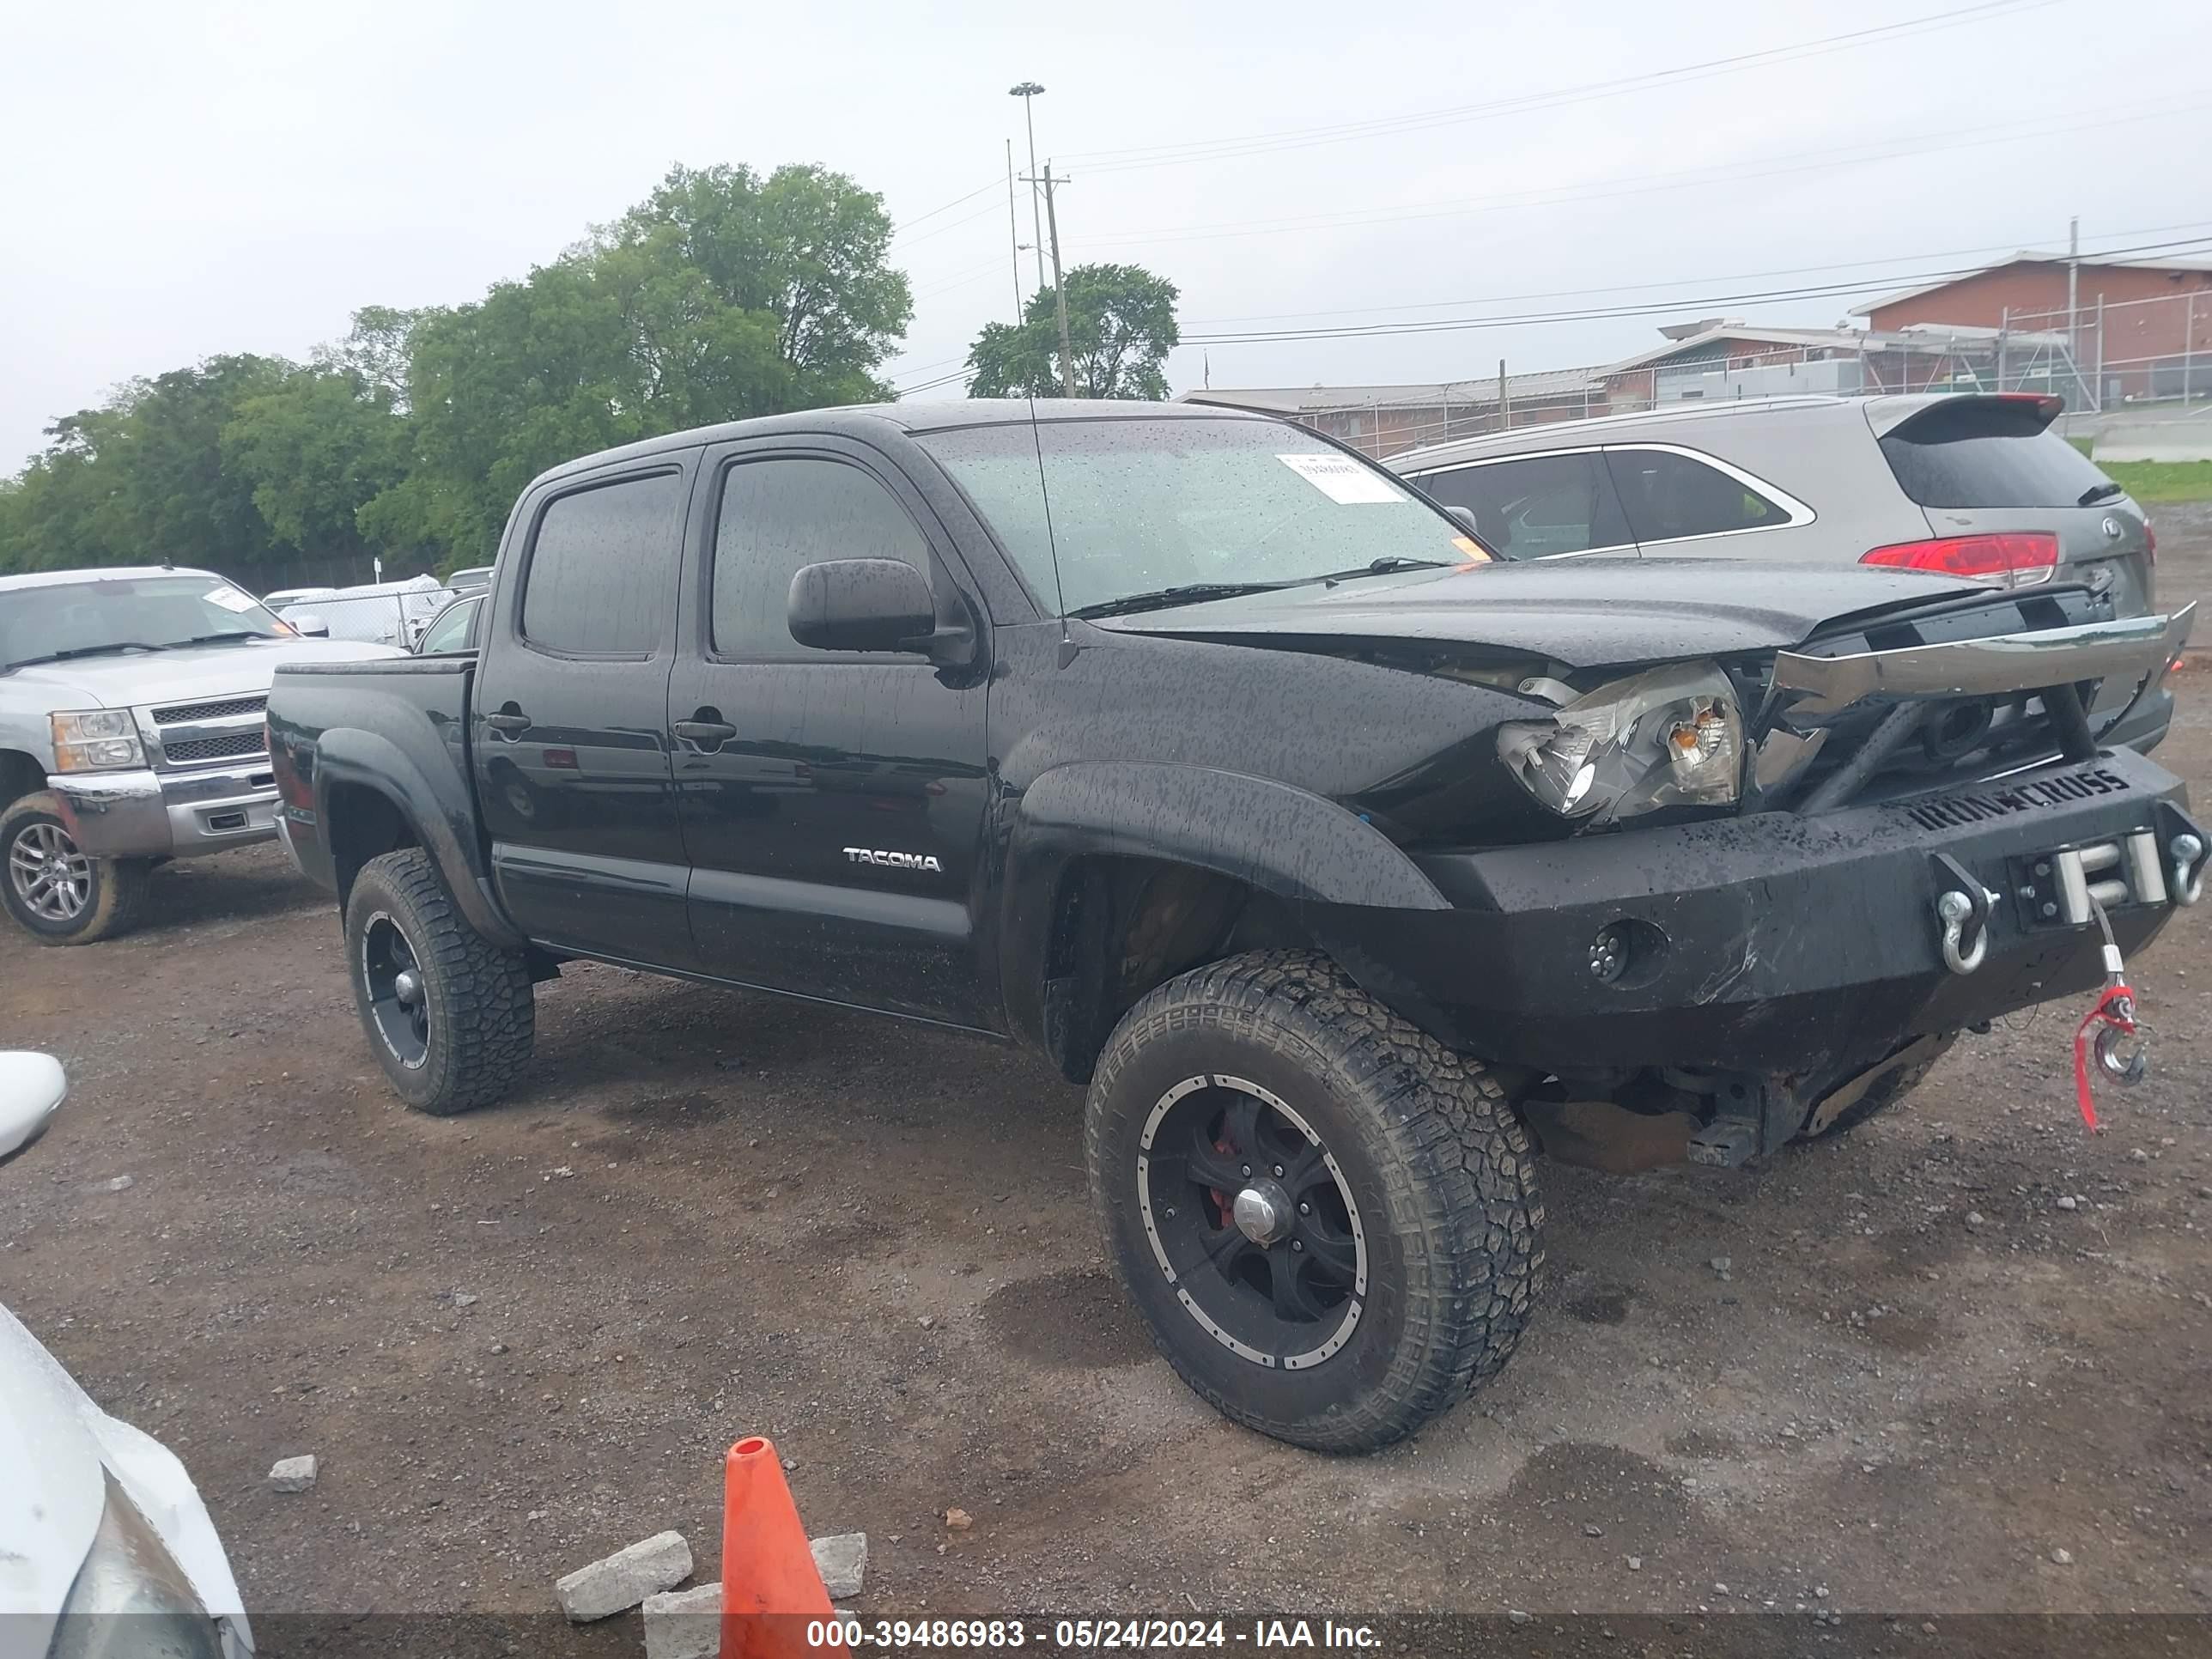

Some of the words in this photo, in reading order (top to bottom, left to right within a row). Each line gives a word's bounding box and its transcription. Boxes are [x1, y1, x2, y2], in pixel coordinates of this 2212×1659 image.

[1907, 795, 2008, 831] IRON
[2014, 769, 2130, 806] CROSS
[842, 847, 942, 872] TACOMA
